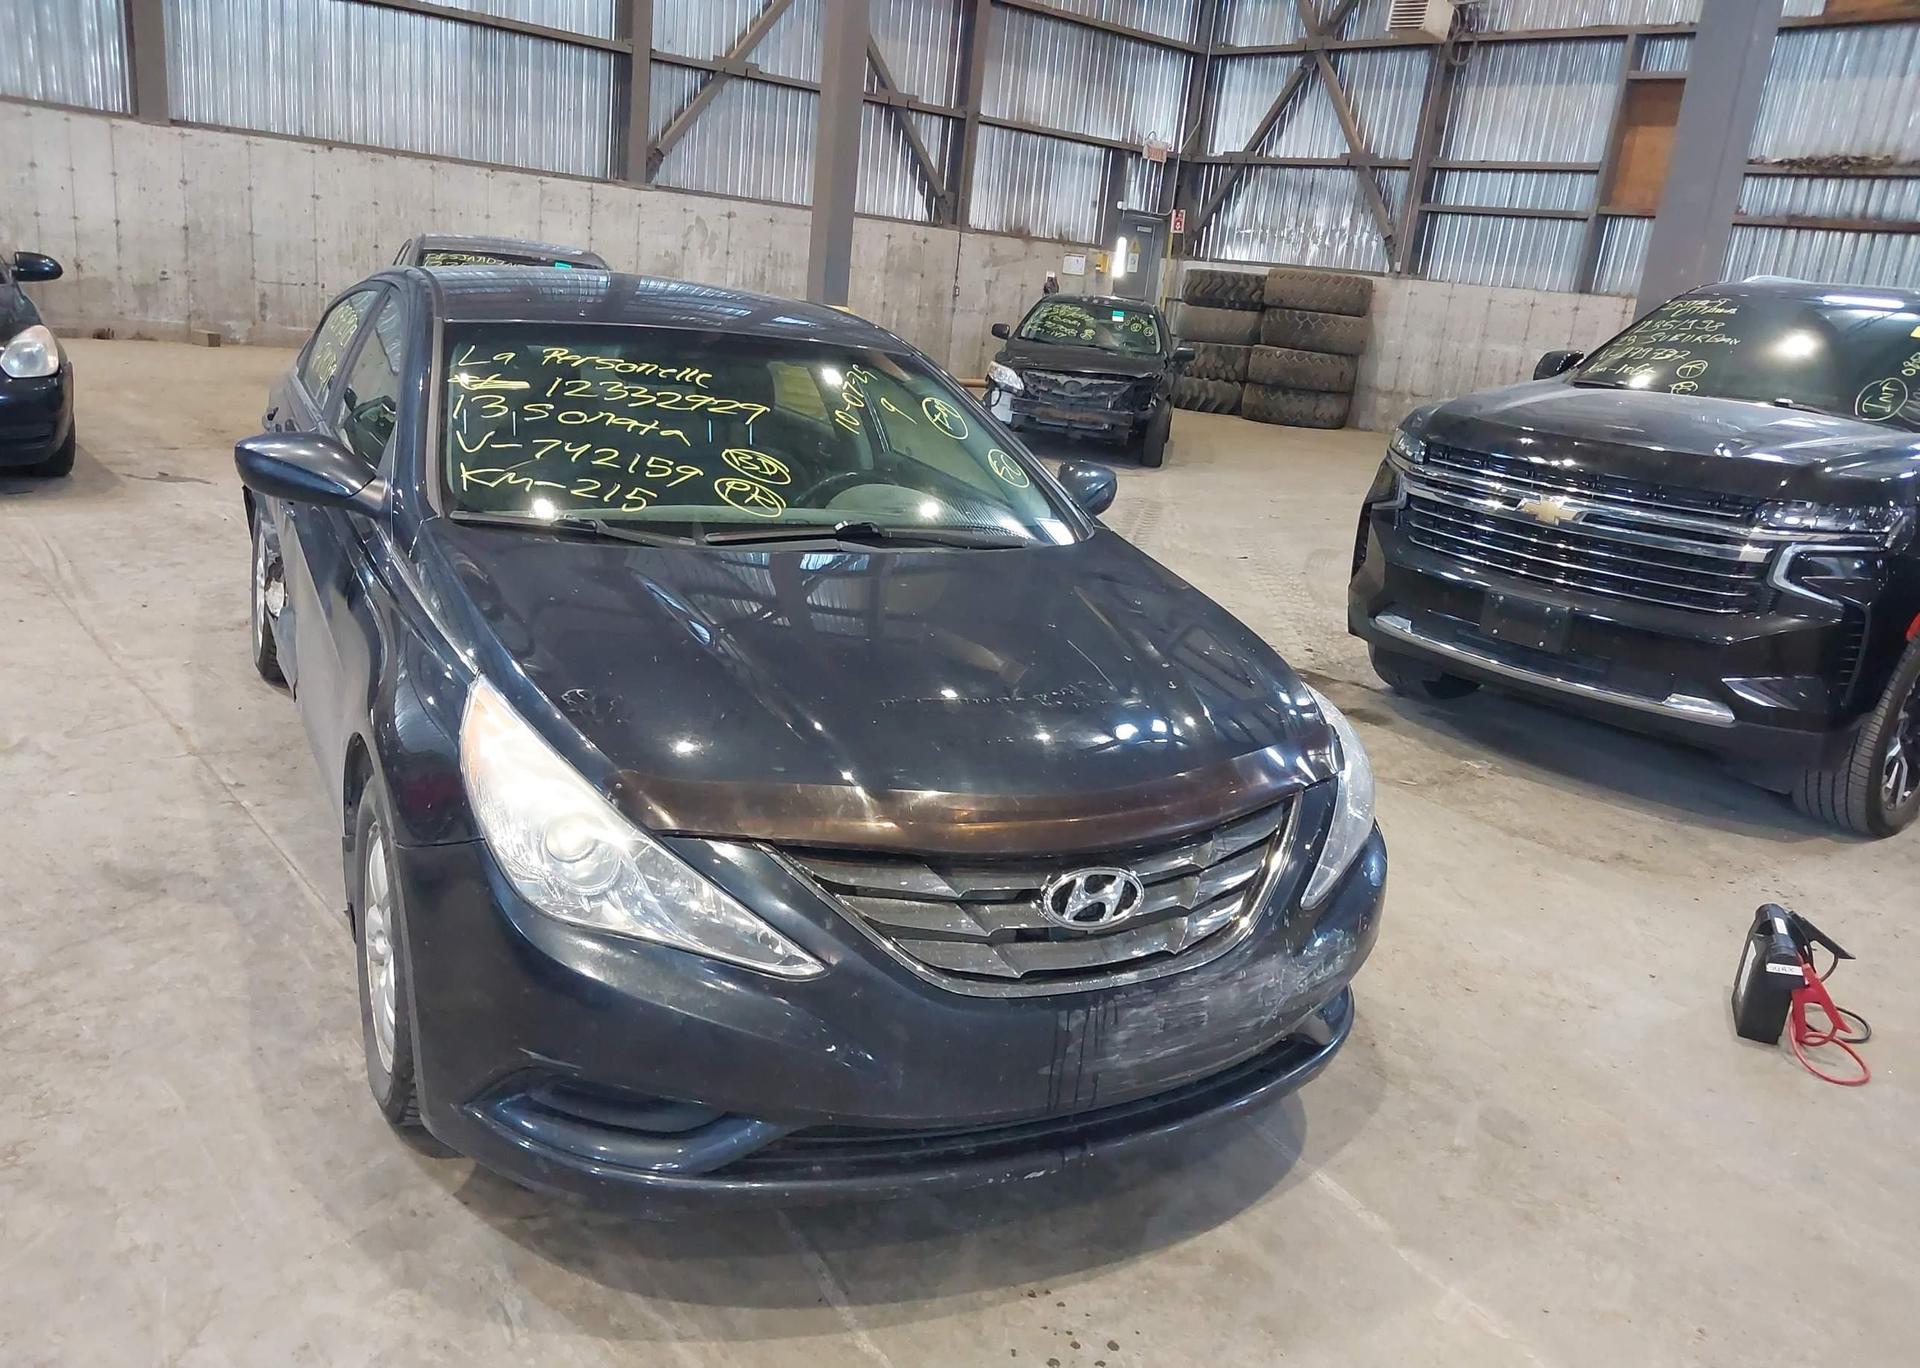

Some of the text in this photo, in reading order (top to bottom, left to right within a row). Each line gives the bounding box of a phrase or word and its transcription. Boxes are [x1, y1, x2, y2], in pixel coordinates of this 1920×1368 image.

[458, 345, 517, 367] La
[453, 394, 509, 420] 13
[546, 377, 772, 426] 12332929
[456, 431, 704, 487] V-742159
